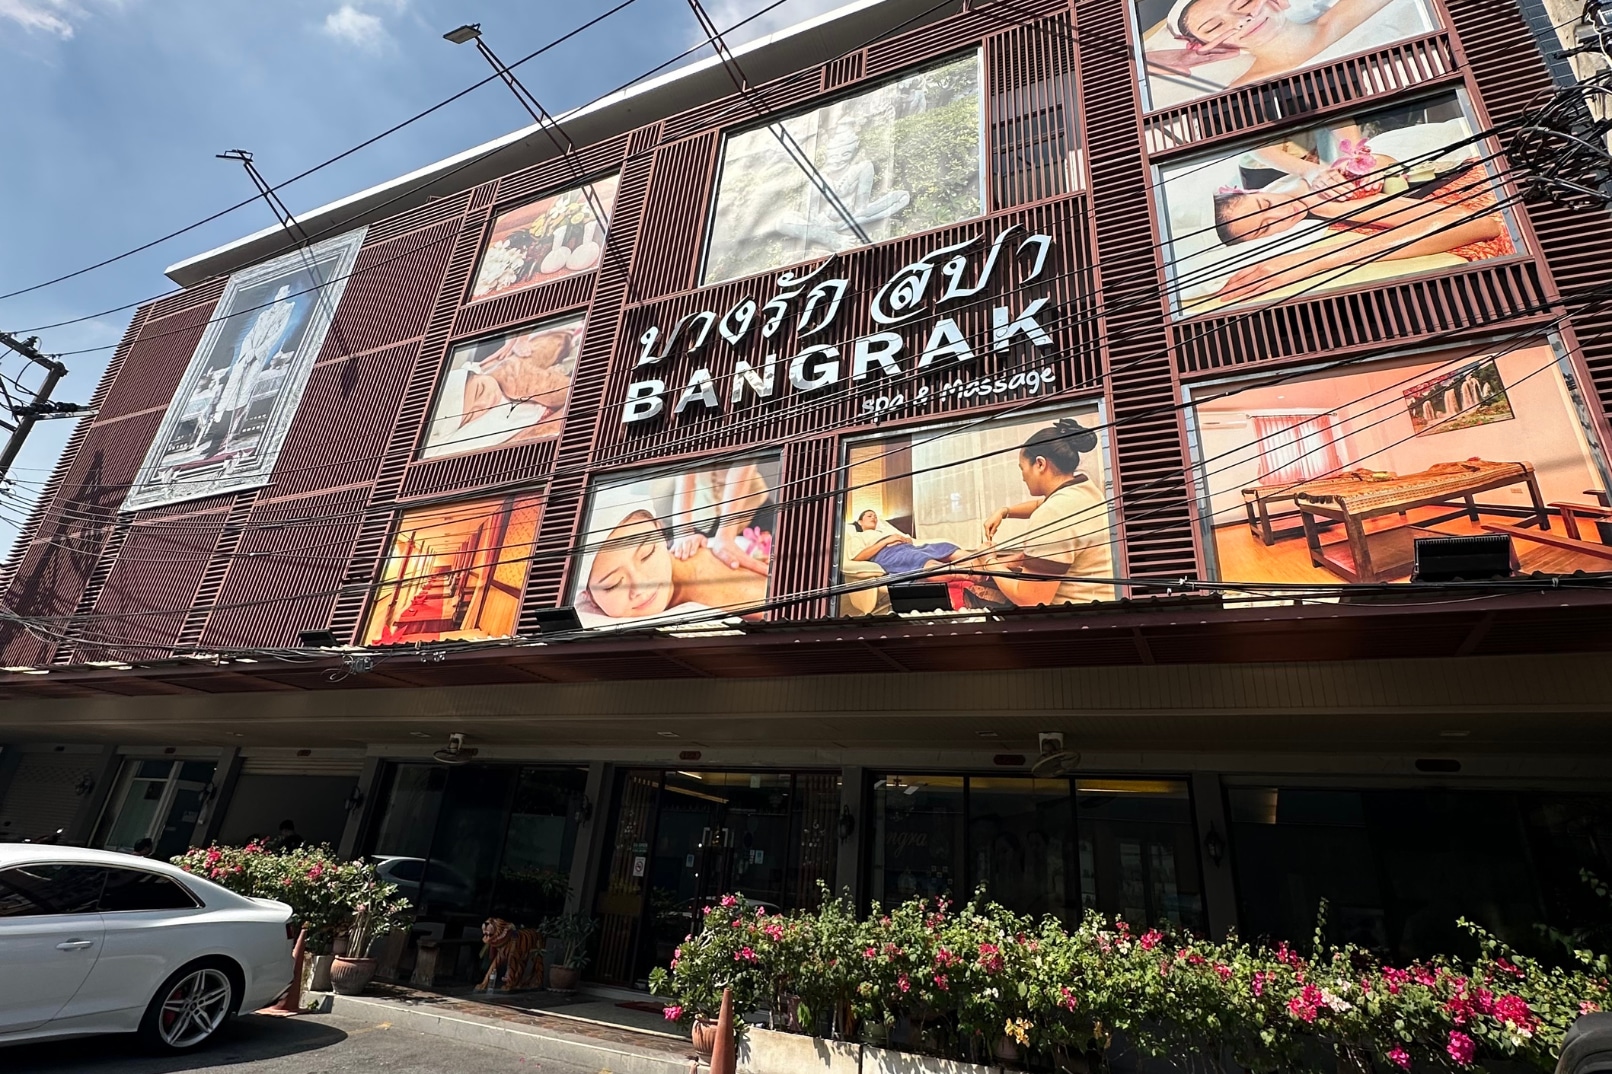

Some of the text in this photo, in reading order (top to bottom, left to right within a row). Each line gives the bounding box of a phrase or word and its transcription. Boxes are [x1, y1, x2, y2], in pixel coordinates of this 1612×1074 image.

[631, 222, 1053, 371] บางรัก สปา
[622, 297, 1055, 424] BANGRAK
[941, 367, 1056, 402] Massage
